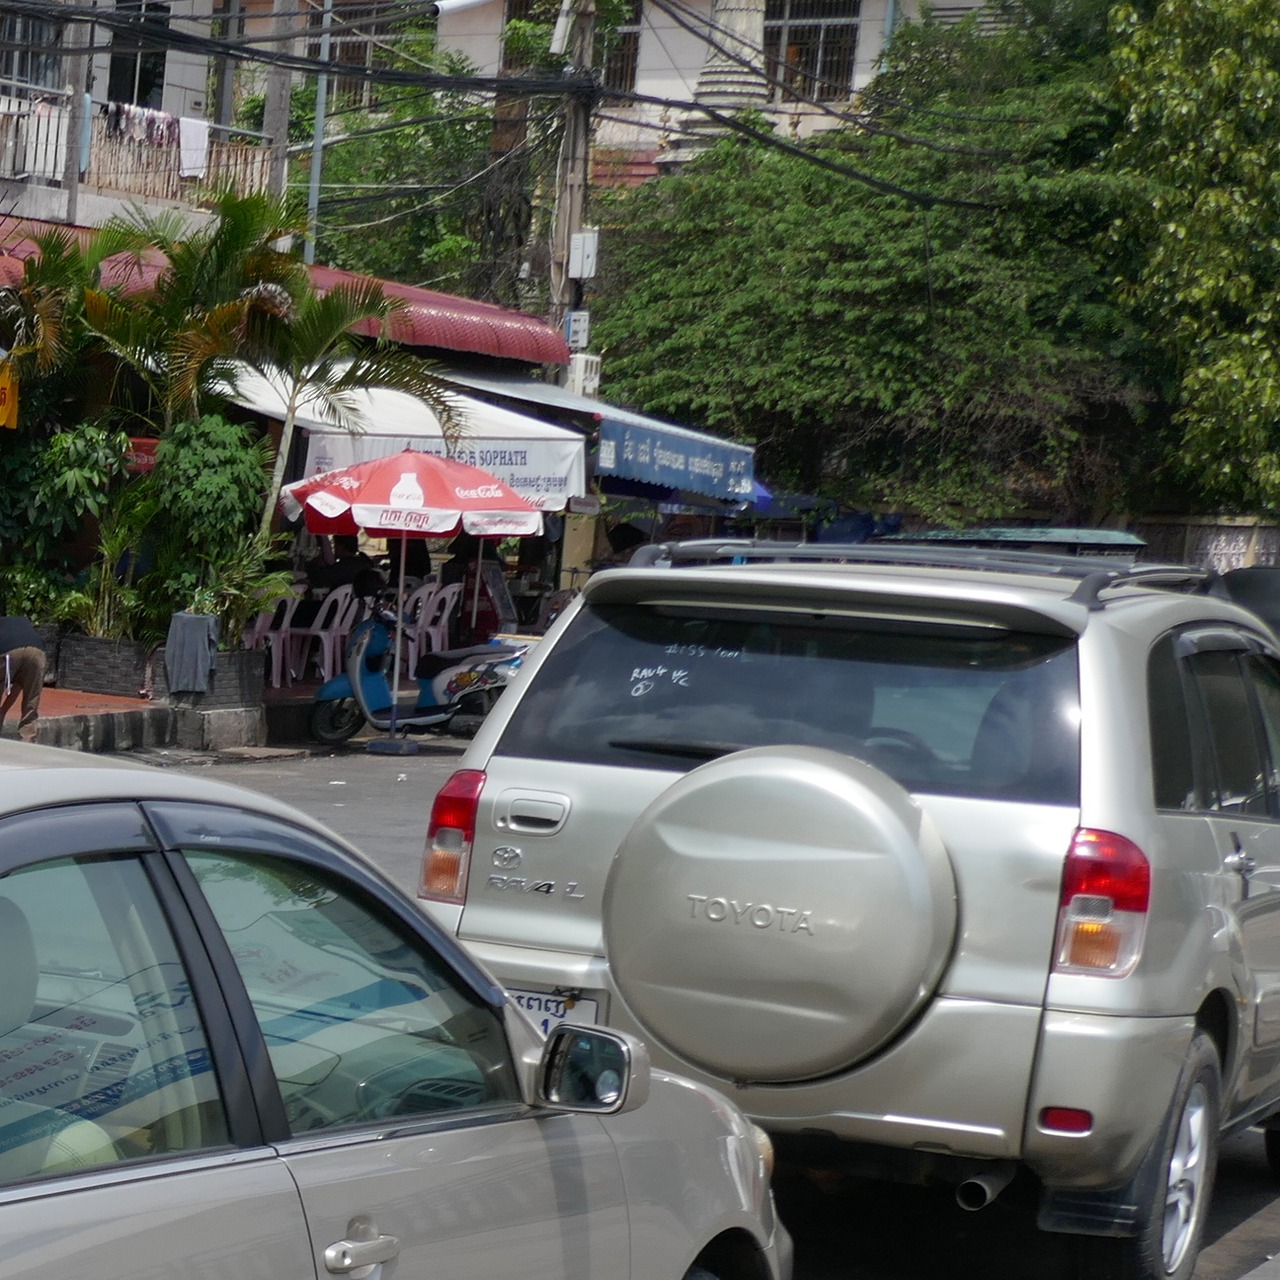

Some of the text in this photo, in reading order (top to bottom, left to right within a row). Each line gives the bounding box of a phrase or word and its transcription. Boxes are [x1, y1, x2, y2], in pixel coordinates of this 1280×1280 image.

[480, 450, 528, 466] SOPHATH
[562, 881, 585, 900] L
[687, 893, 814, 936] TOYOTA
